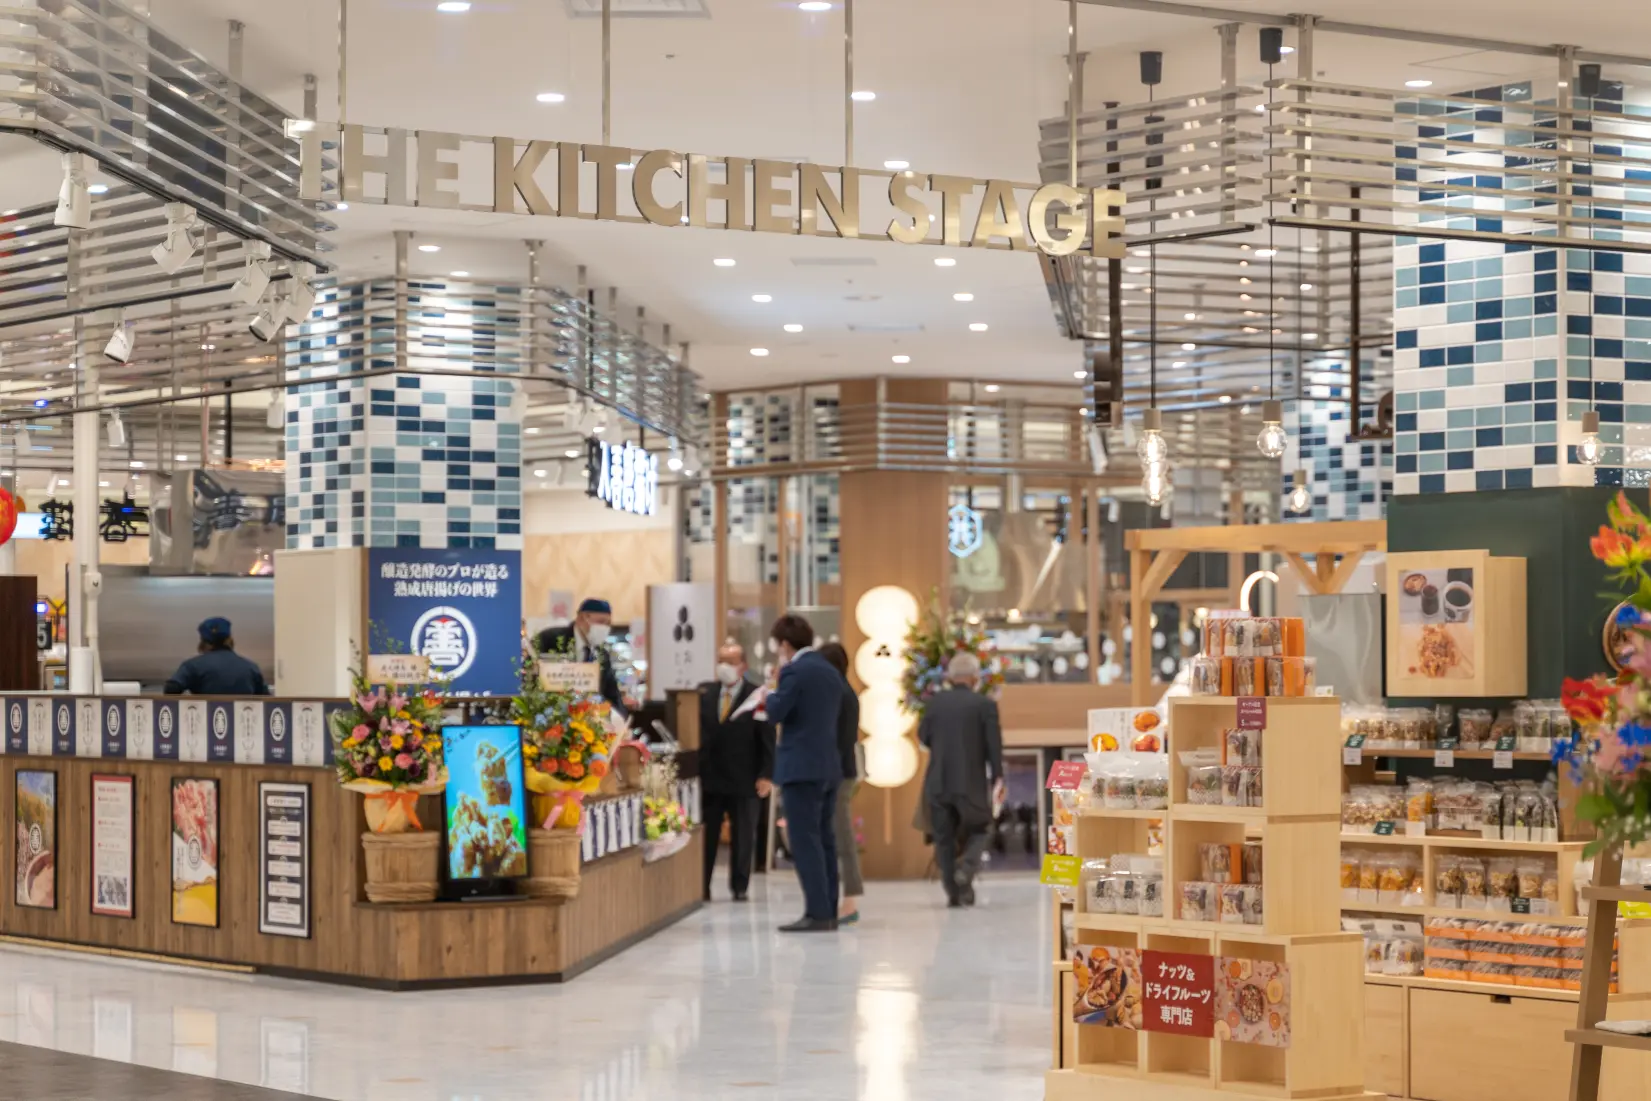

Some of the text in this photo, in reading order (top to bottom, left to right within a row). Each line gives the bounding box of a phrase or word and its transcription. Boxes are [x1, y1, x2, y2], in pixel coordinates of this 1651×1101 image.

[284, 119, 1127, 259] THE KITCHEN STAGE
[1158, 961, 1195, 982] ナッツ&
[1145, 981, 1212, 1004] ドライフルーツ
[1160, 1004, 1194, 1027] 専門店
